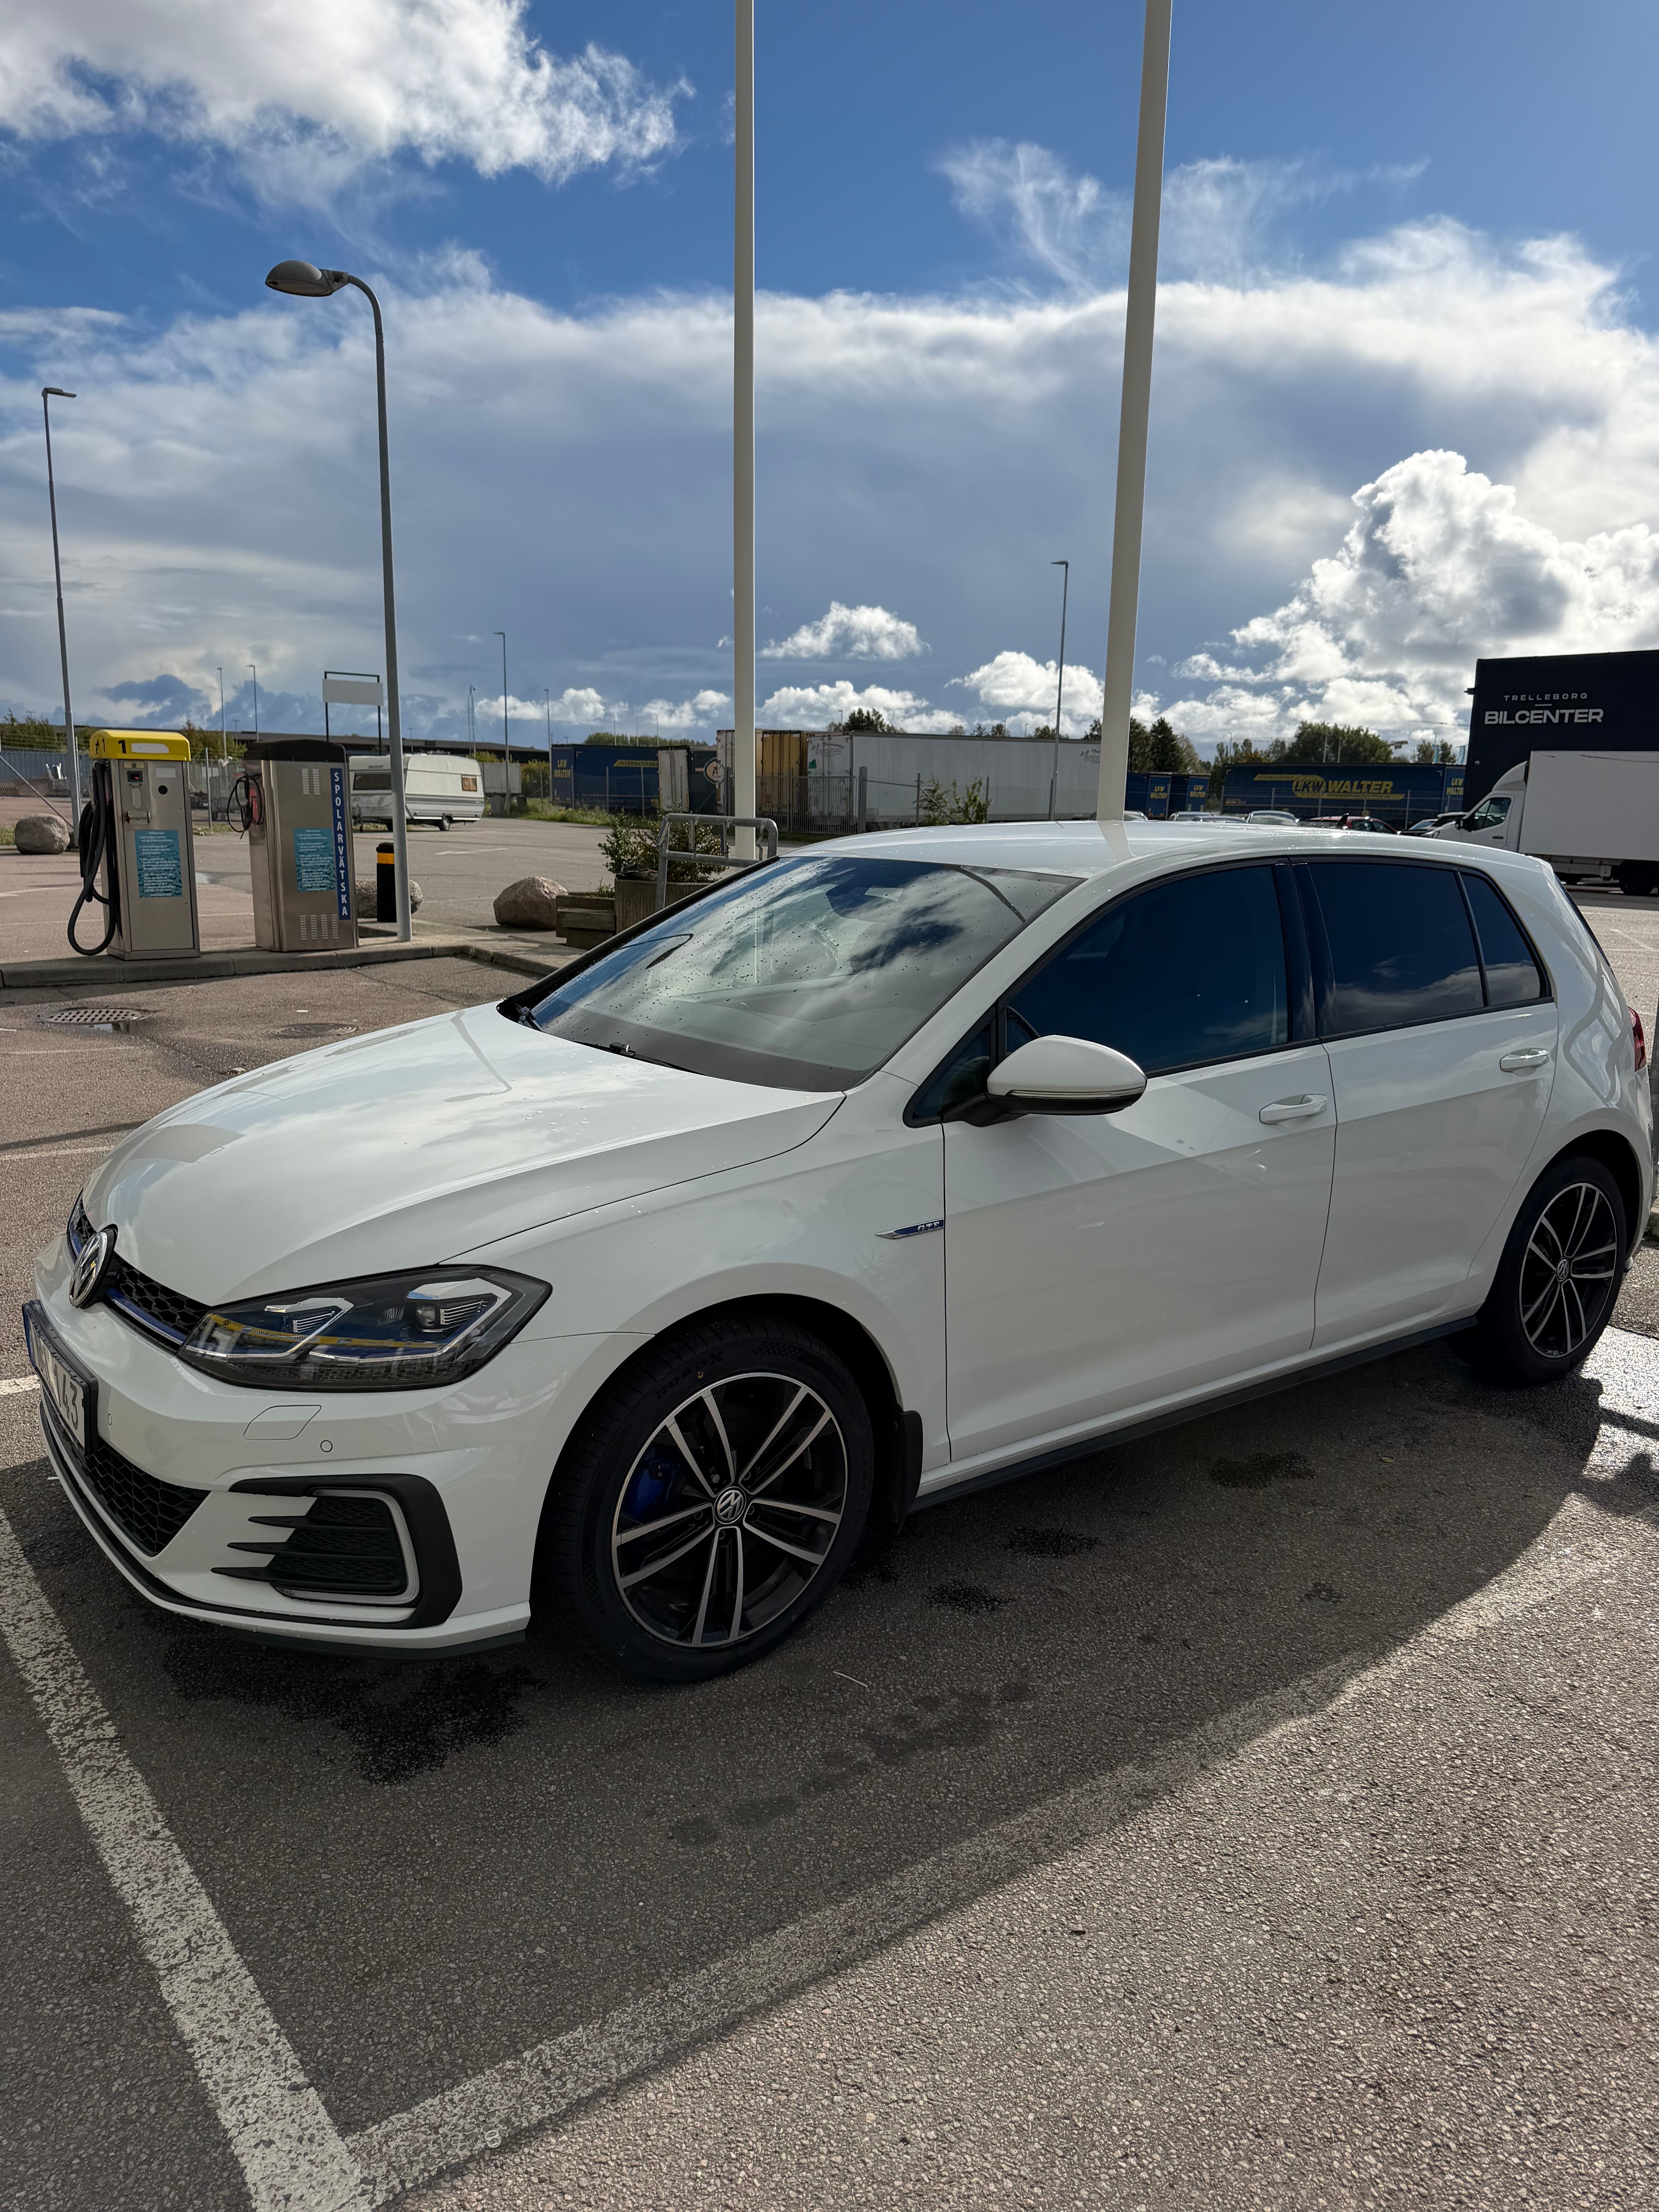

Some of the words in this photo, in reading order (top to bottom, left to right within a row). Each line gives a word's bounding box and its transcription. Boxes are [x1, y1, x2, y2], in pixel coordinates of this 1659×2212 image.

[1504, 693, 1587, 701] TRELLEBORG
[1484, 709, 1604, 725] BILCENTER
[118, 740, 127, 754] 1
[1295, 780, 1324, 792] LKW
[1328, 780, 1393, 794] WALTER
[1446, 787, 1464, 795] WALTE
[334, 772, 348, 916] SPOLARVÄTSKA
[917, 1221, 939, 1233] GTE
[654, 1350, 724, 1400] ROADX
